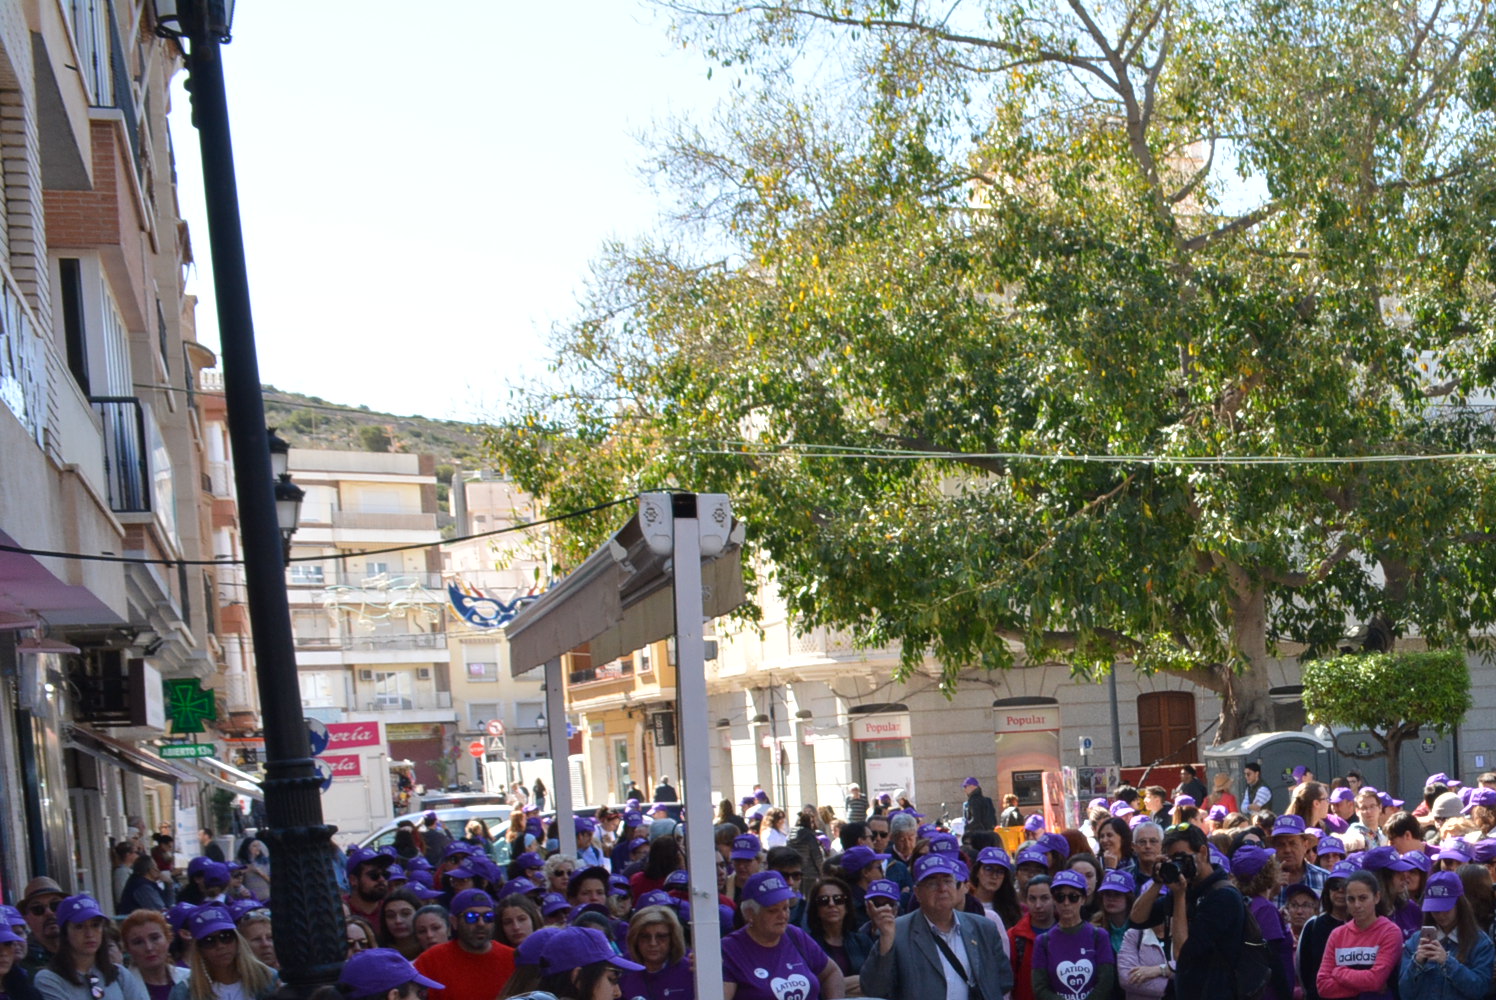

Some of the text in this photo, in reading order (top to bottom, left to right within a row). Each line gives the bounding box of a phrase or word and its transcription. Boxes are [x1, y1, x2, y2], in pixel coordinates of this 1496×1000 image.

[1007, 715, 1045, 726] Popular
[866, 722, 902, 734] Popular
[162, 747, 196, 757] ABIERTO
[1338, 951, 1377, 962] adidas
[1060, 965, 1091, 976] LATIDO
[775, 980, 806, 993] LATIDO
[1070, 977, 1083, 985] en
